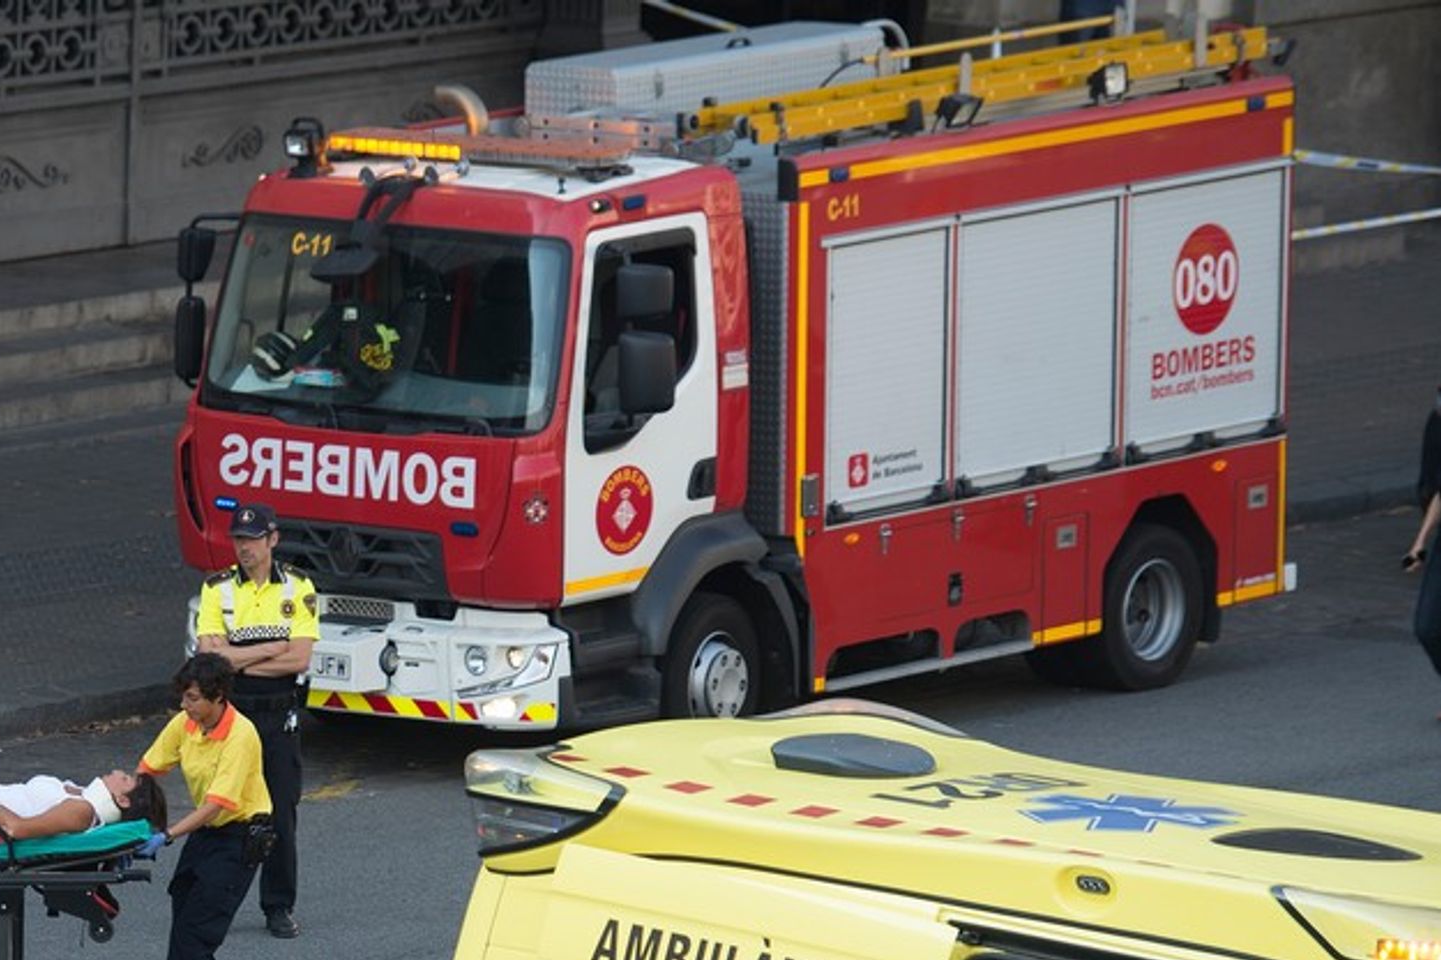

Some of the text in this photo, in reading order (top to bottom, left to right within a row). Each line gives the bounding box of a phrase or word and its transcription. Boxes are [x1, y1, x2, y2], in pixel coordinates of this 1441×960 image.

[827, 192, 859, 221] C-11
[291, 231, 332, 257] C-11
[1175, 250, 1237, 309] 080
[1151, 335, 1256, 380] BOMBERS
